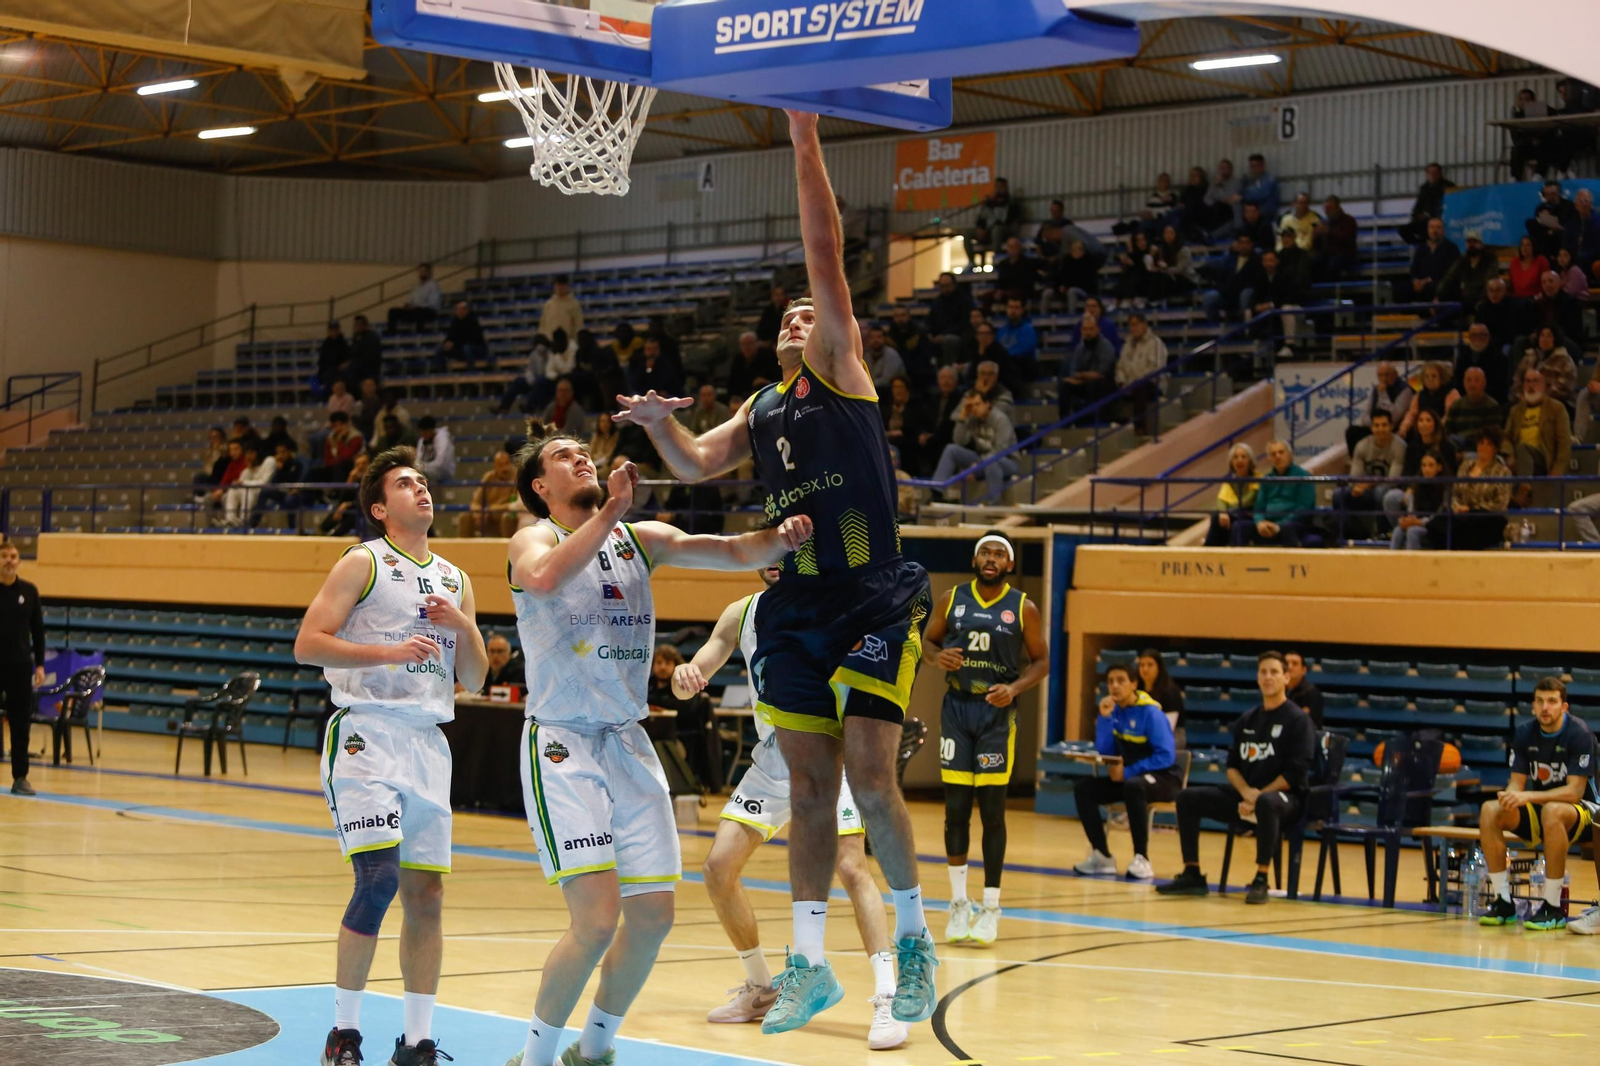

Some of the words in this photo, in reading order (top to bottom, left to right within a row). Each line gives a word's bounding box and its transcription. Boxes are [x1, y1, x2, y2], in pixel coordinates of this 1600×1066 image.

[715, 7, 807, 44] SPORT
[807, 0, 925, 41] SYSTEM
[1282, 107, 1295, 138] B
[928, 138, 964, 162] Bar
[702, 163, 713, 188] A
[776, 436, 796, 472] 2
[598, 550, 612, 572] 8
[1161, 560, 1226, 578] PRENSA
[1289, 563, 1310, 580] TV
[417, 576, 435, 595] 16
[967, 630, 991, 652] 20
[343, 814, 386, 833] amiab
[564, 831, 613, 851] amiab
[1510, 861, 1533, 872] KIPST
